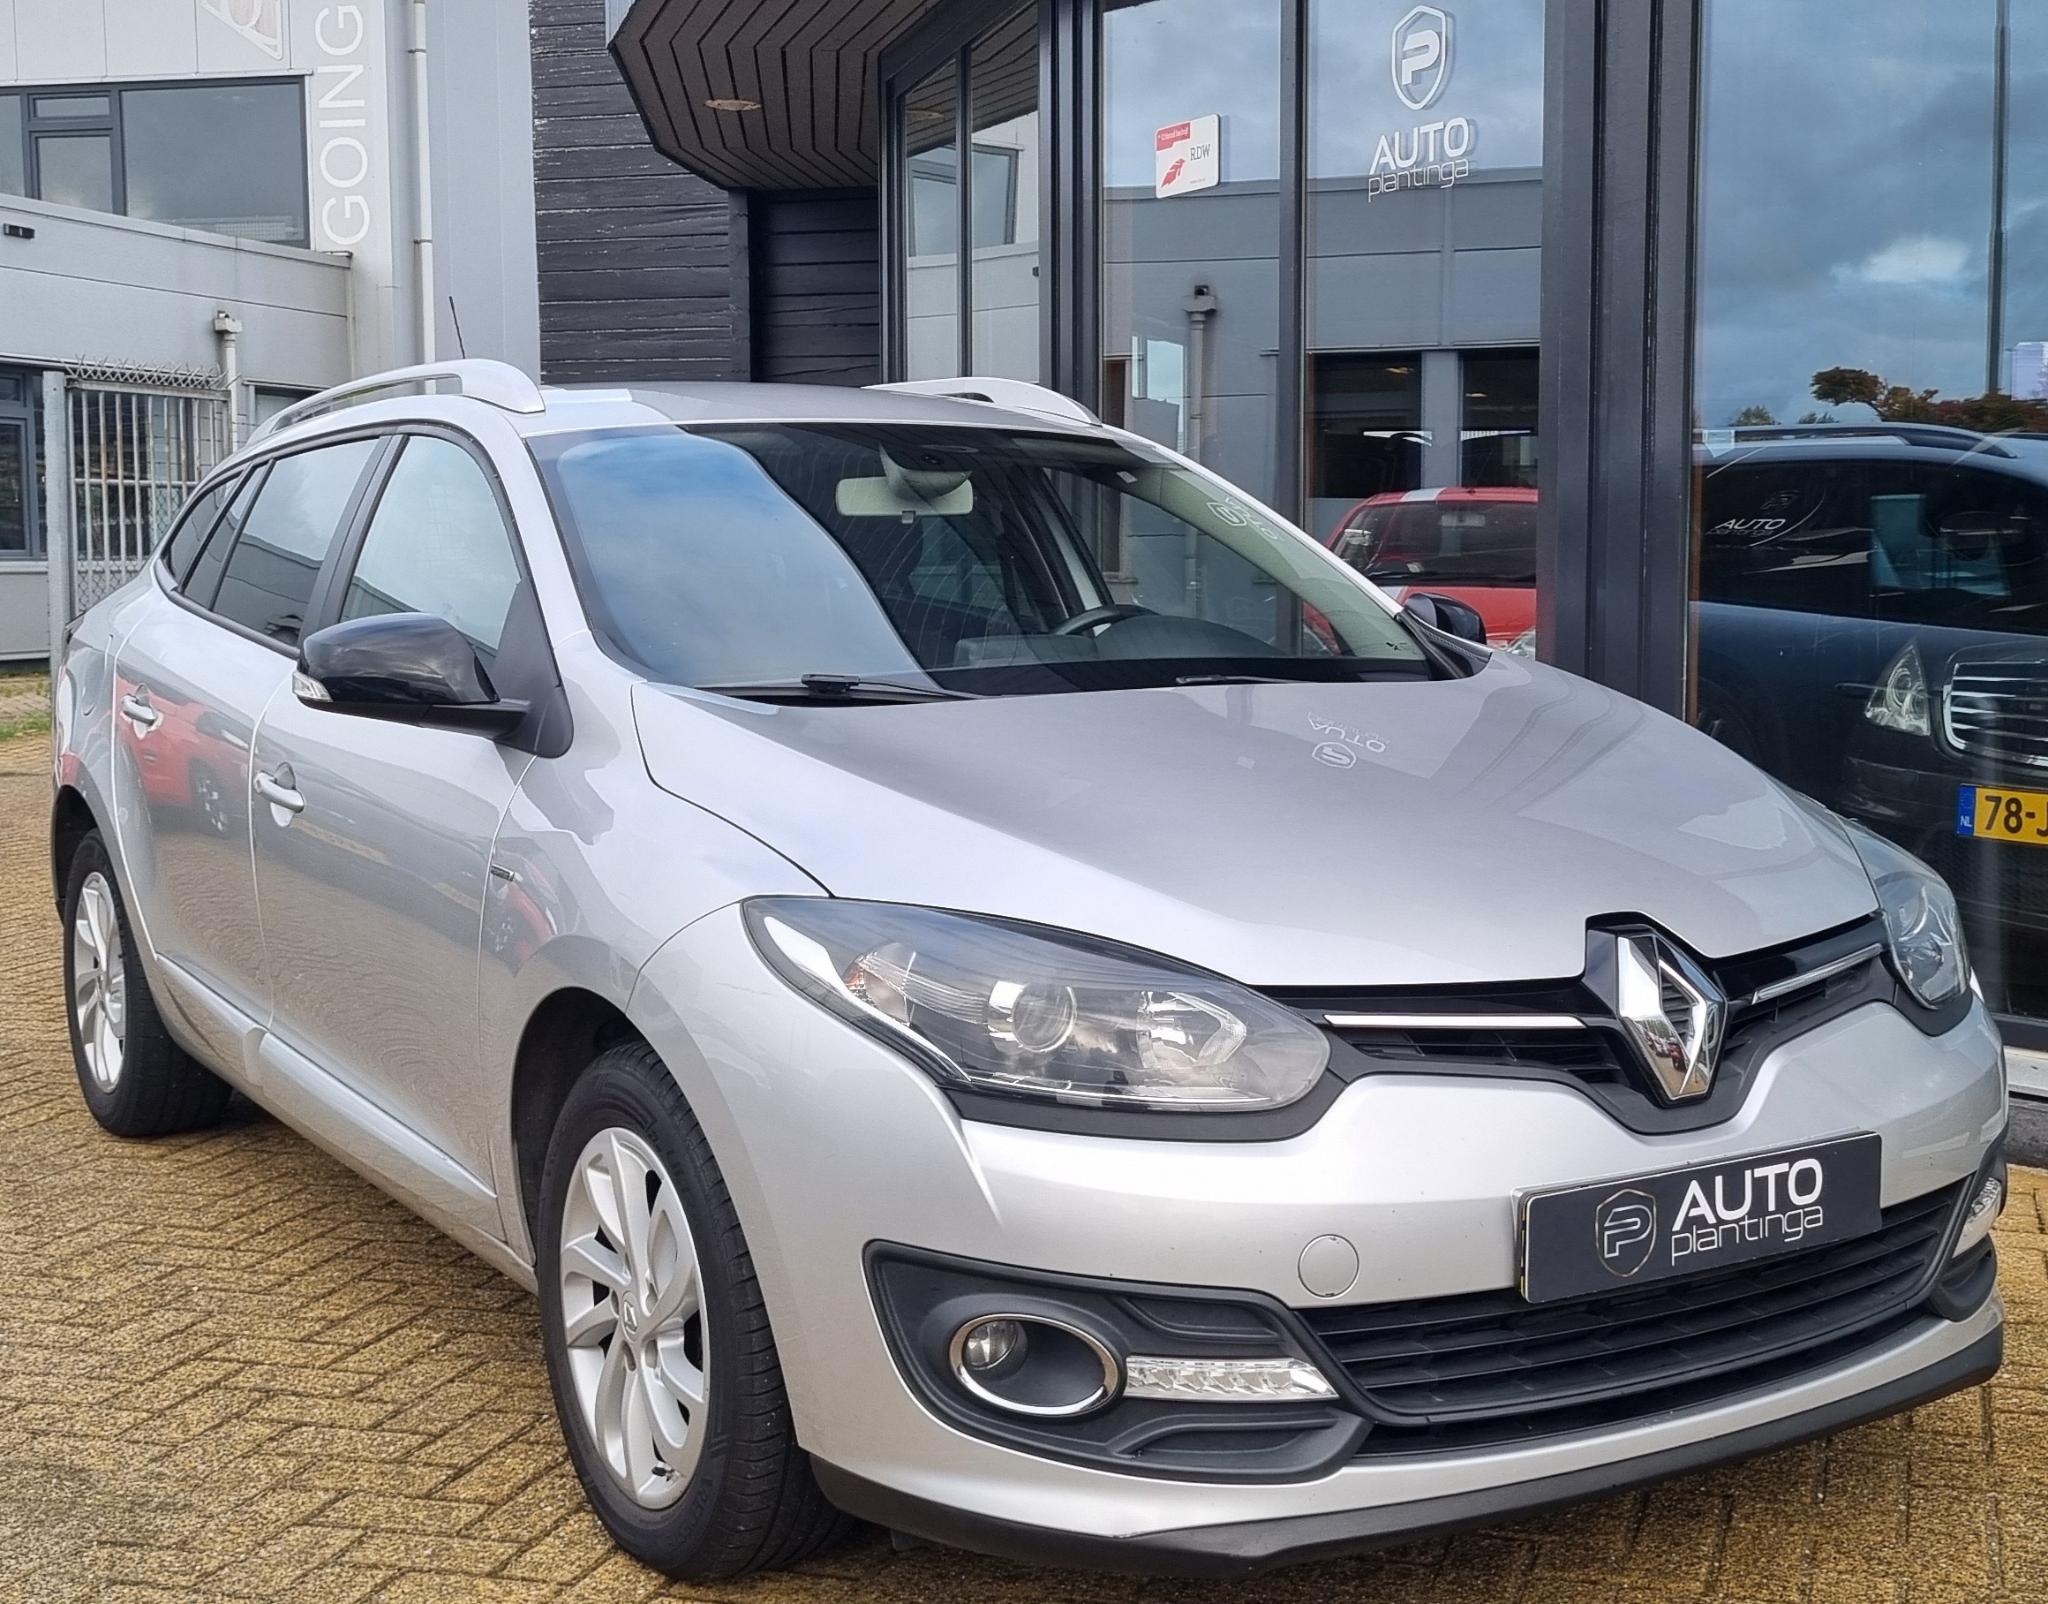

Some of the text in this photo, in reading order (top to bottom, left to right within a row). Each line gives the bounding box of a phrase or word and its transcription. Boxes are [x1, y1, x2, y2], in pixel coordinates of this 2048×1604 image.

[315, 5, 370, 245] GOING
[1369, 117, 1469, 175] AUTO
[1190, 143, 1211, 161] RDW
[1368, 158, 1469, 203] plantinga
[1714, 518, 1786, 530] AUTO
[1960, 815, 1973, 828] NL
[1672, 1158, 1823, 1232] AUTO
[1672, 1205, 1823, 1267] plantinga
